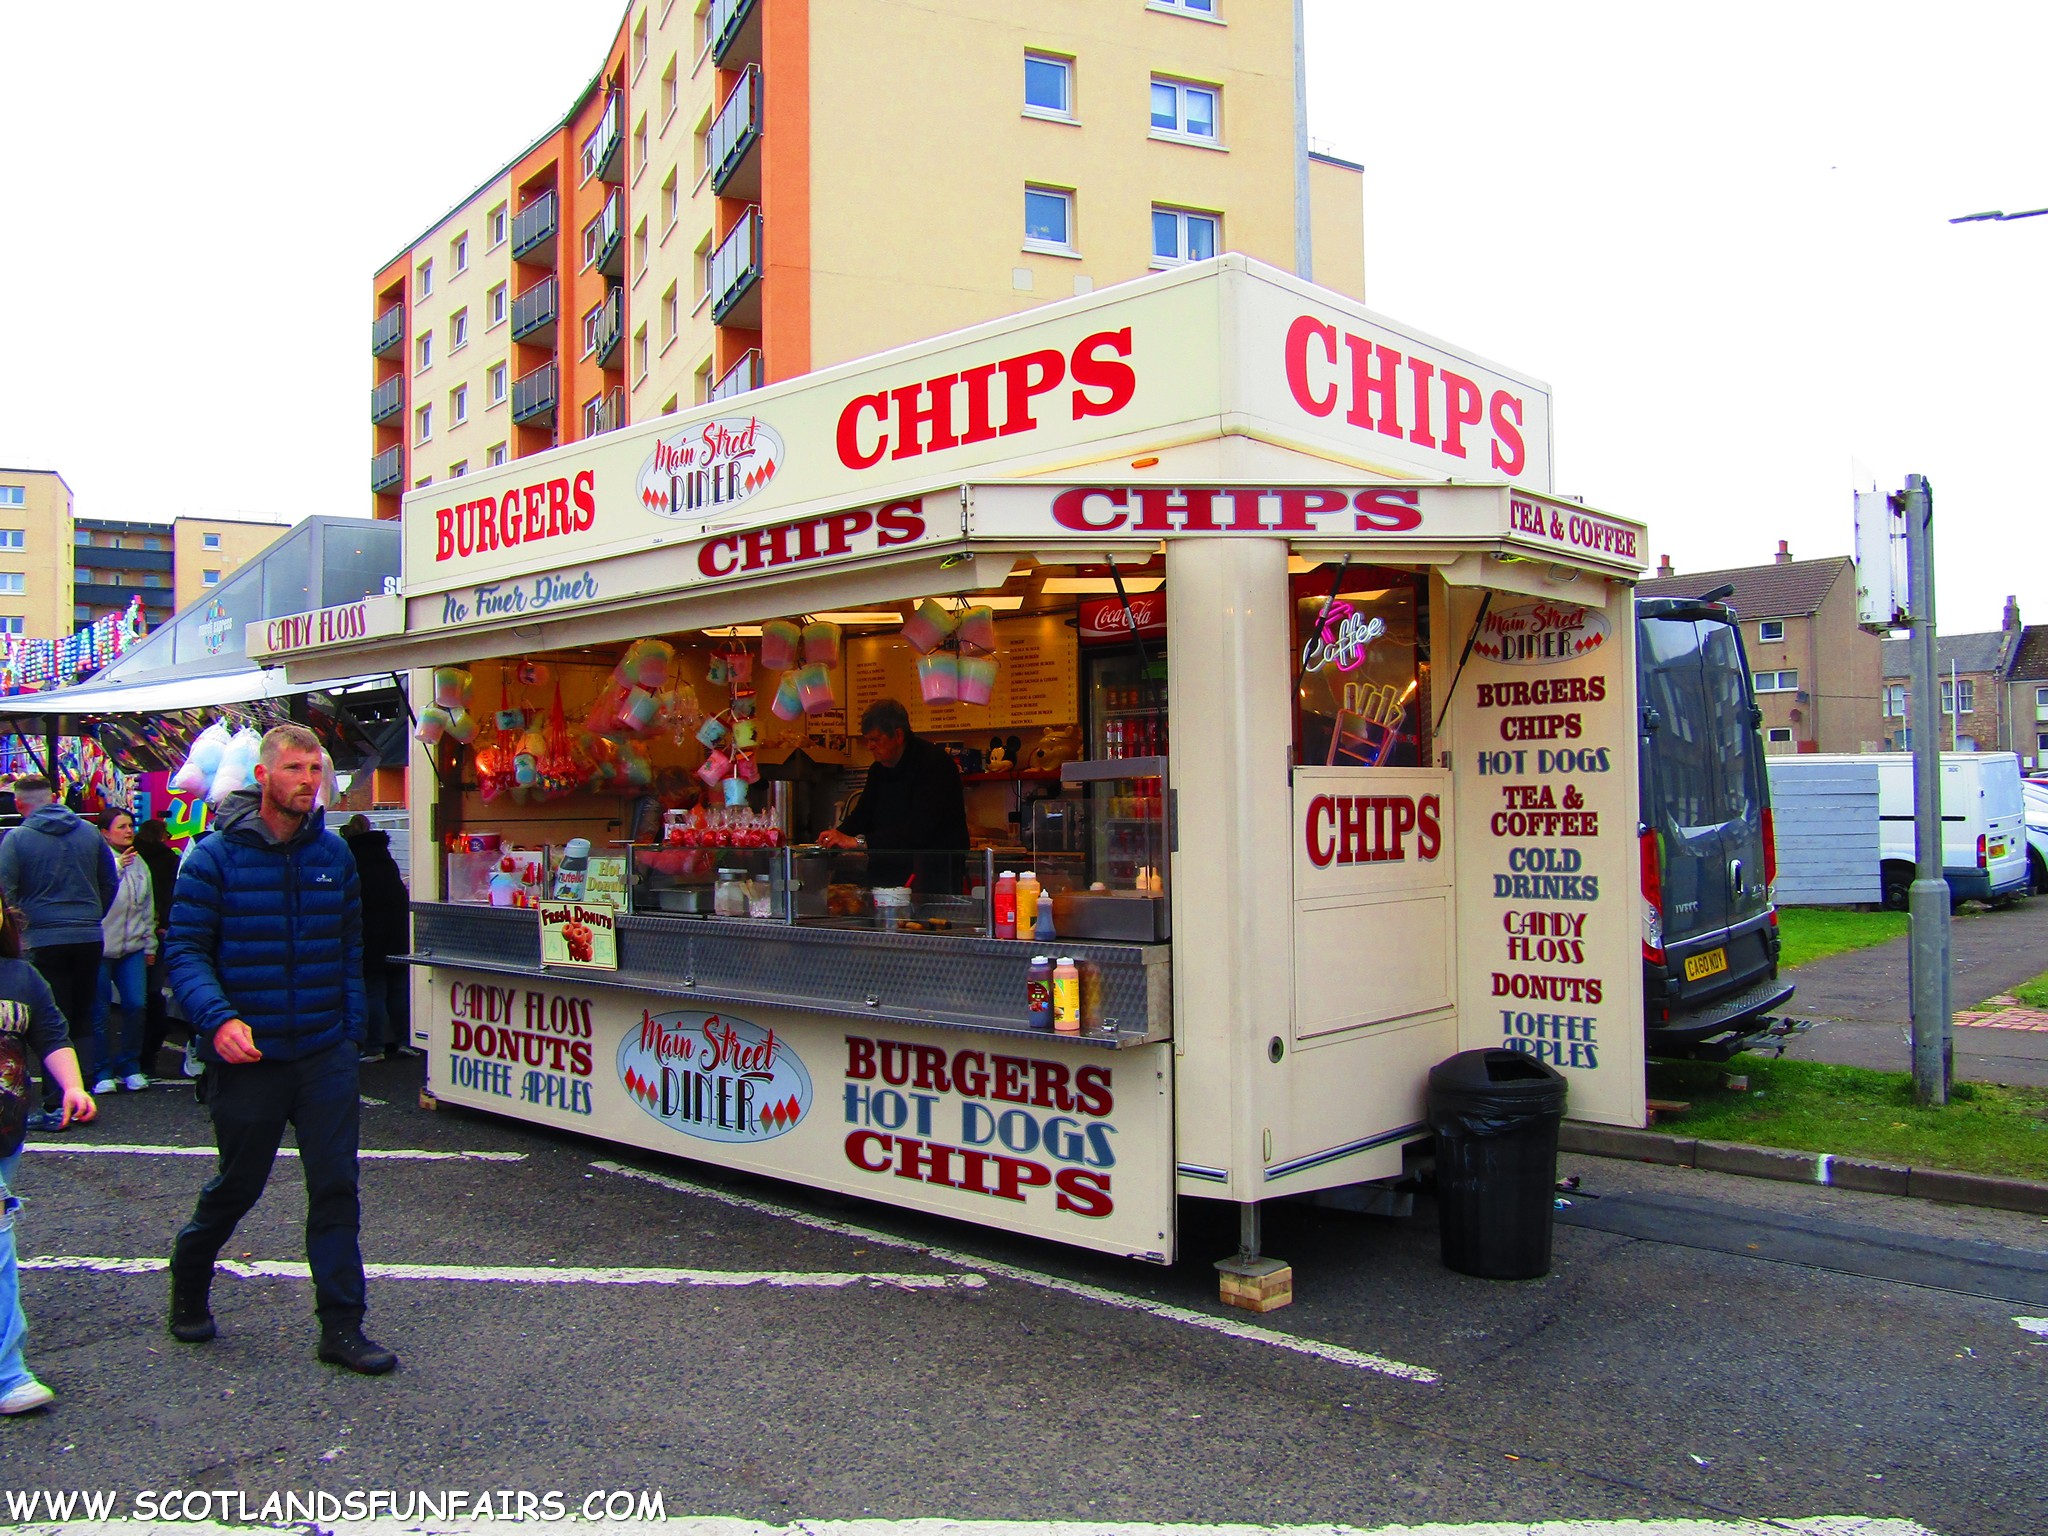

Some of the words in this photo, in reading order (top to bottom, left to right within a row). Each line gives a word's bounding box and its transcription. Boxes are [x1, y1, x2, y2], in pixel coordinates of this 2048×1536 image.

[836, 326, 1136, 470] CHIPS
[1284, 314, 1527, 477] CHIPS
[653, 437, 696, 476] Main
[699, 416, 761, 466] Street
[670, 460, 744, 514] DINER
[1050, 487, 1425, 540] CHIPS
[435, 470, 595, 562] BURGERS
[697, 498, 926, 579] CHIPS
[1511, 499, 1546, 536] TEA
[1550, 511, 1565, 541] &
[1569, 515, 1636, 558] COFFEE
[442, 592, 469, 624] No
[474, 585, 527, 617] Finer
[530, 571, 598, 609] Diner
[1484, 610, 1526, 636] Main
[1531, 604, 1588, 633] Street
[267, 613, 315, 651] CANDY
[319, 603, 366, 643] FLOSS
[1302, 612, 1387, 672] Coffee
[1502, 631, 1573, 660] DINER
[1476, 675, 1606, 709] BURGERS
[1499, 713, 1582, 742] CHIPS
[1477, 749, 1529, 776] HOT
[1538, 746, 1611, 774] DOGS
[1490, 810, 1599, 838] COFFEE
[1501, 785, 1557, 810] TEA
[1561, 785, 1584, 810] &
[1305, 792, 1441, 870] CHIPS
[1507, 847, 1582, 873] COLD
[1493, 873, 1599, 901] DRINKS
[1503, 910, 1587, 938] CANDY
[1507, 937, 1585, 965] FLOSS
[450, 980, 514, 1024] CANDY
[525, 992, 594, 1038] FLOSS
[1491, 972, 1603, 1004] DONUTS
[450, 1022, 594, 1076] DONUTS
[640, 1009, 694, 1066] Main
[700, 1015, 781, 1074] Street
[1498, 1009, 1598, 1043] TOFFEE
[845, 1036, 1114, 1118] BURGERS
[1502, 1037, 1599, 1070] APPLES
[450, 1055, 515, 1098] TOFFEE
[520, 1072, 593, 1116] APPLES
[661, 1066, 757, 1134] DINER
[844, 1083, 937, 1136] HOT
[960, 1102, 1117, 1169] DOGS
[844, 1130, 1113, 1218] CHIPS
